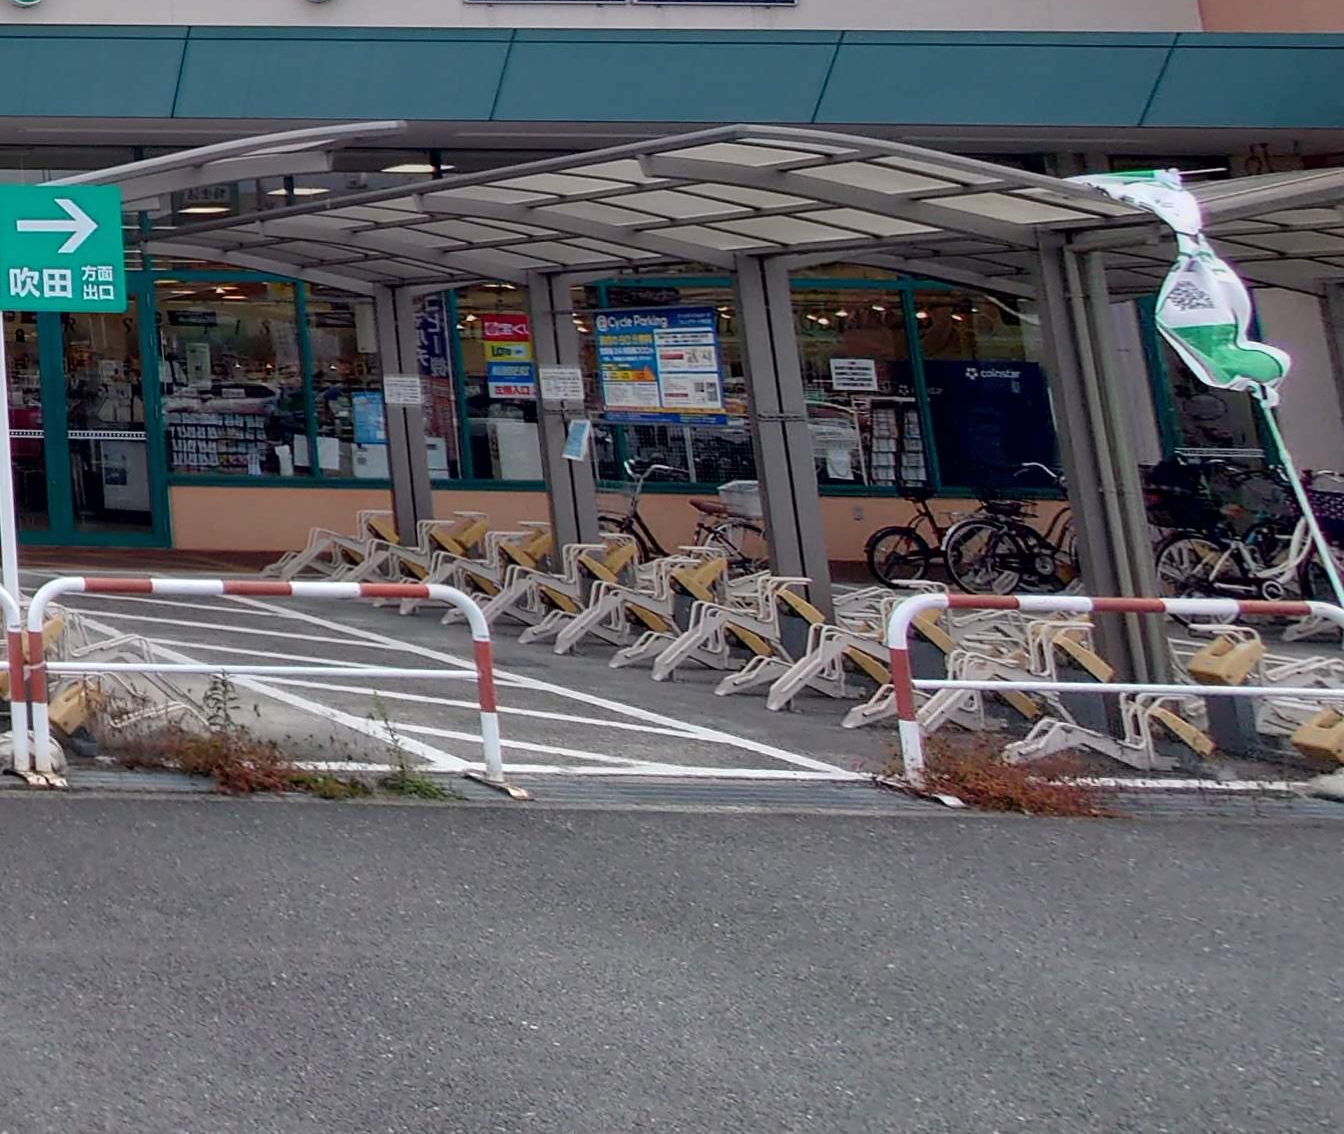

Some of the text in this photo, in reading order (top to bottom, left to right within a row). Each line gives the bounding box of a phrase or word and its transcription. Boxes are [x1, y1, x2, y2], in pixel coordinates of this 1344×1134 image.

[81, 265, 113, 282] 方面
[9, 267, 73, 299] 吹田
[83, 284, 115, 300] 出口
[980, 368, 1021, 378] coinstar
